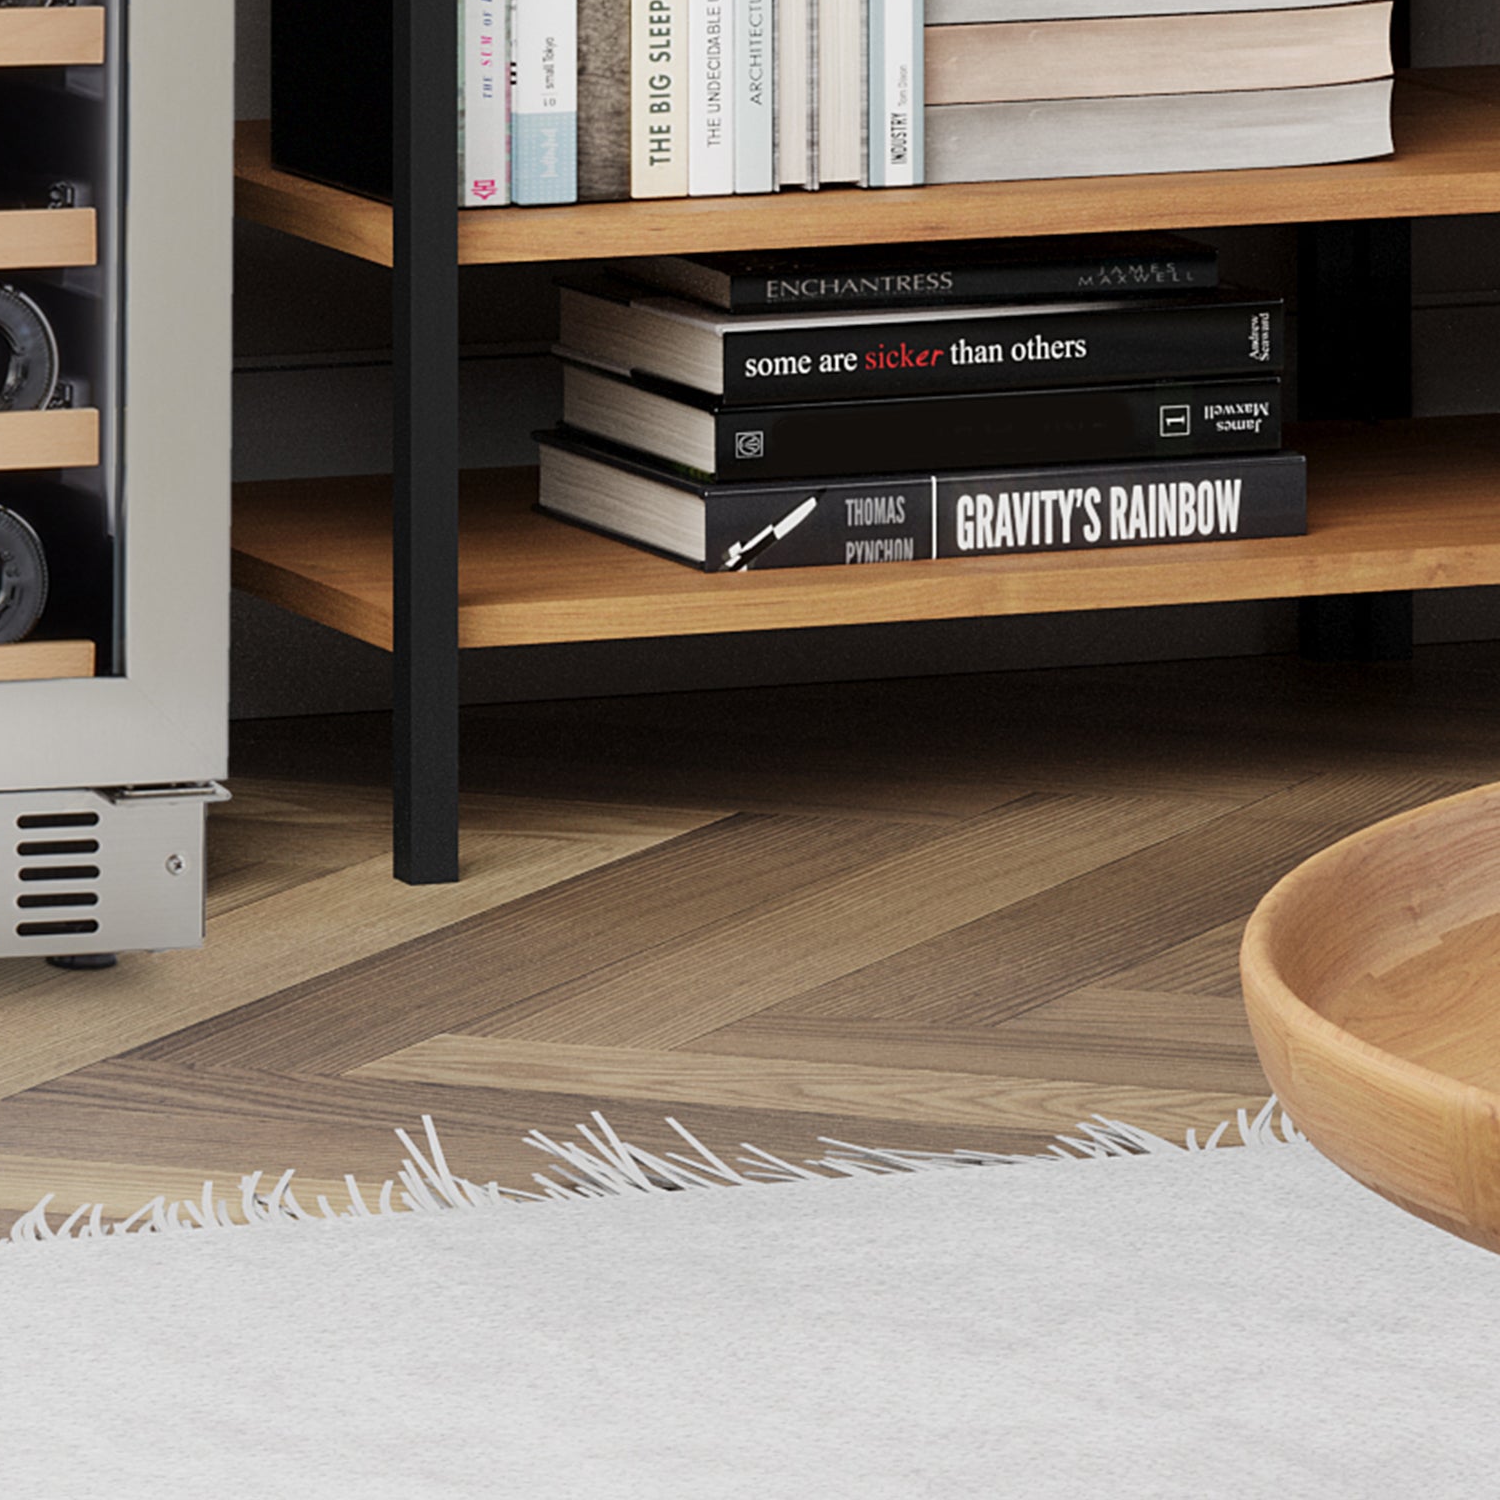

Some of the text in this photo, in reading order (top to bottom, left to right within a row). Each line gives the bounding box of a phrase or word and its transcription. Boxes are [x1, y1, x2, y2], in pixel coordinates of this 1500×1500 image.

[482, 11, 493, 25] OF
[480, 36, 493, 67] SUM
[707, 7, 721, 113] UNDECIDABLE
[482, 77, 493, 99] THE
[649, 0, 671, 166] THE BIG SLEEP
[707, 119, 721, 146] THE
[890, 112, 908, 165] INDUSTRY
[1078, 271, 1194, 286] MAXWELL
[1099, 262, 1176, 277] JAMES
[766, 271, 954, 299] ENCHANTRESS
[1248, 315, 1259, 360] Andrew
[744, 334, 1087, 378] some are sicker than others
[1203, 402, 1269, 420] Maxwell
[1215, 418, 1263, 434] James
[845, 495, 906, 527] THOMAS
[956, 478, 1242, 551] GRAVITY'S RAINBOW
